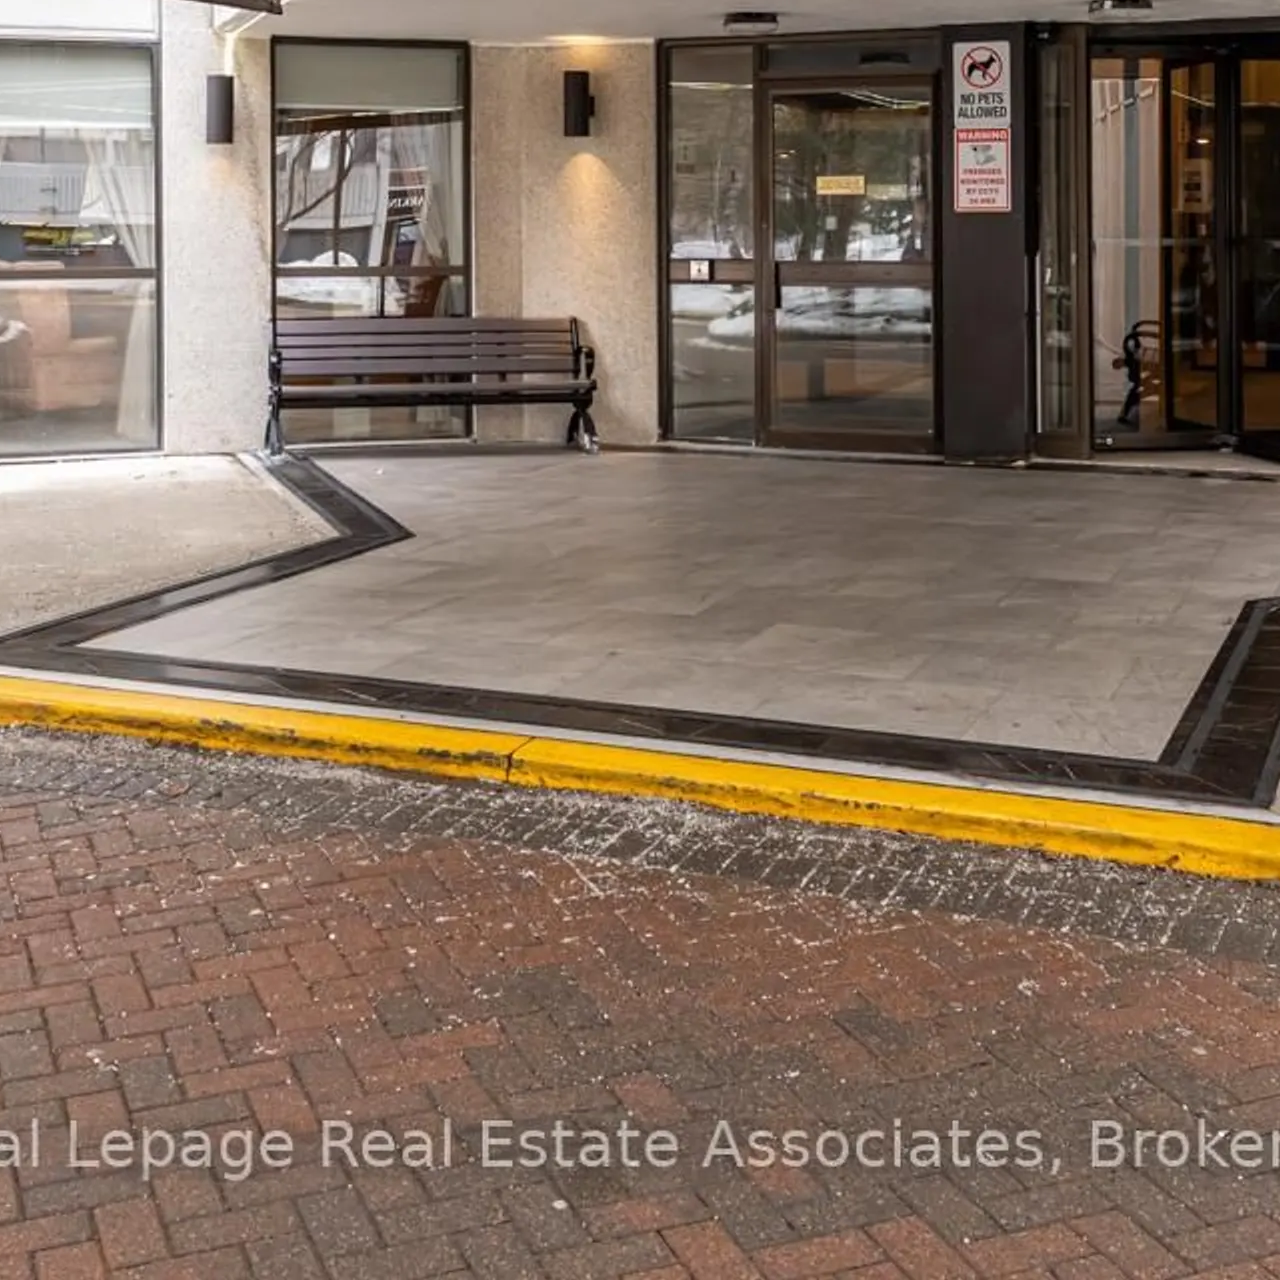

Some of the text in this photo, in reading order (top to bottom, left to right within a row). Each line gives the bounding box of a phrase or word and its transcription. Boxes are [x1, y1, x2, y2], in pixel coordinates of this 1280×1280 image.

[960, 92, 1005, 106] NO PETS
[958, 106, 1008, 120] ALLOWED
[960, 130, 1008, 140] WARNING
